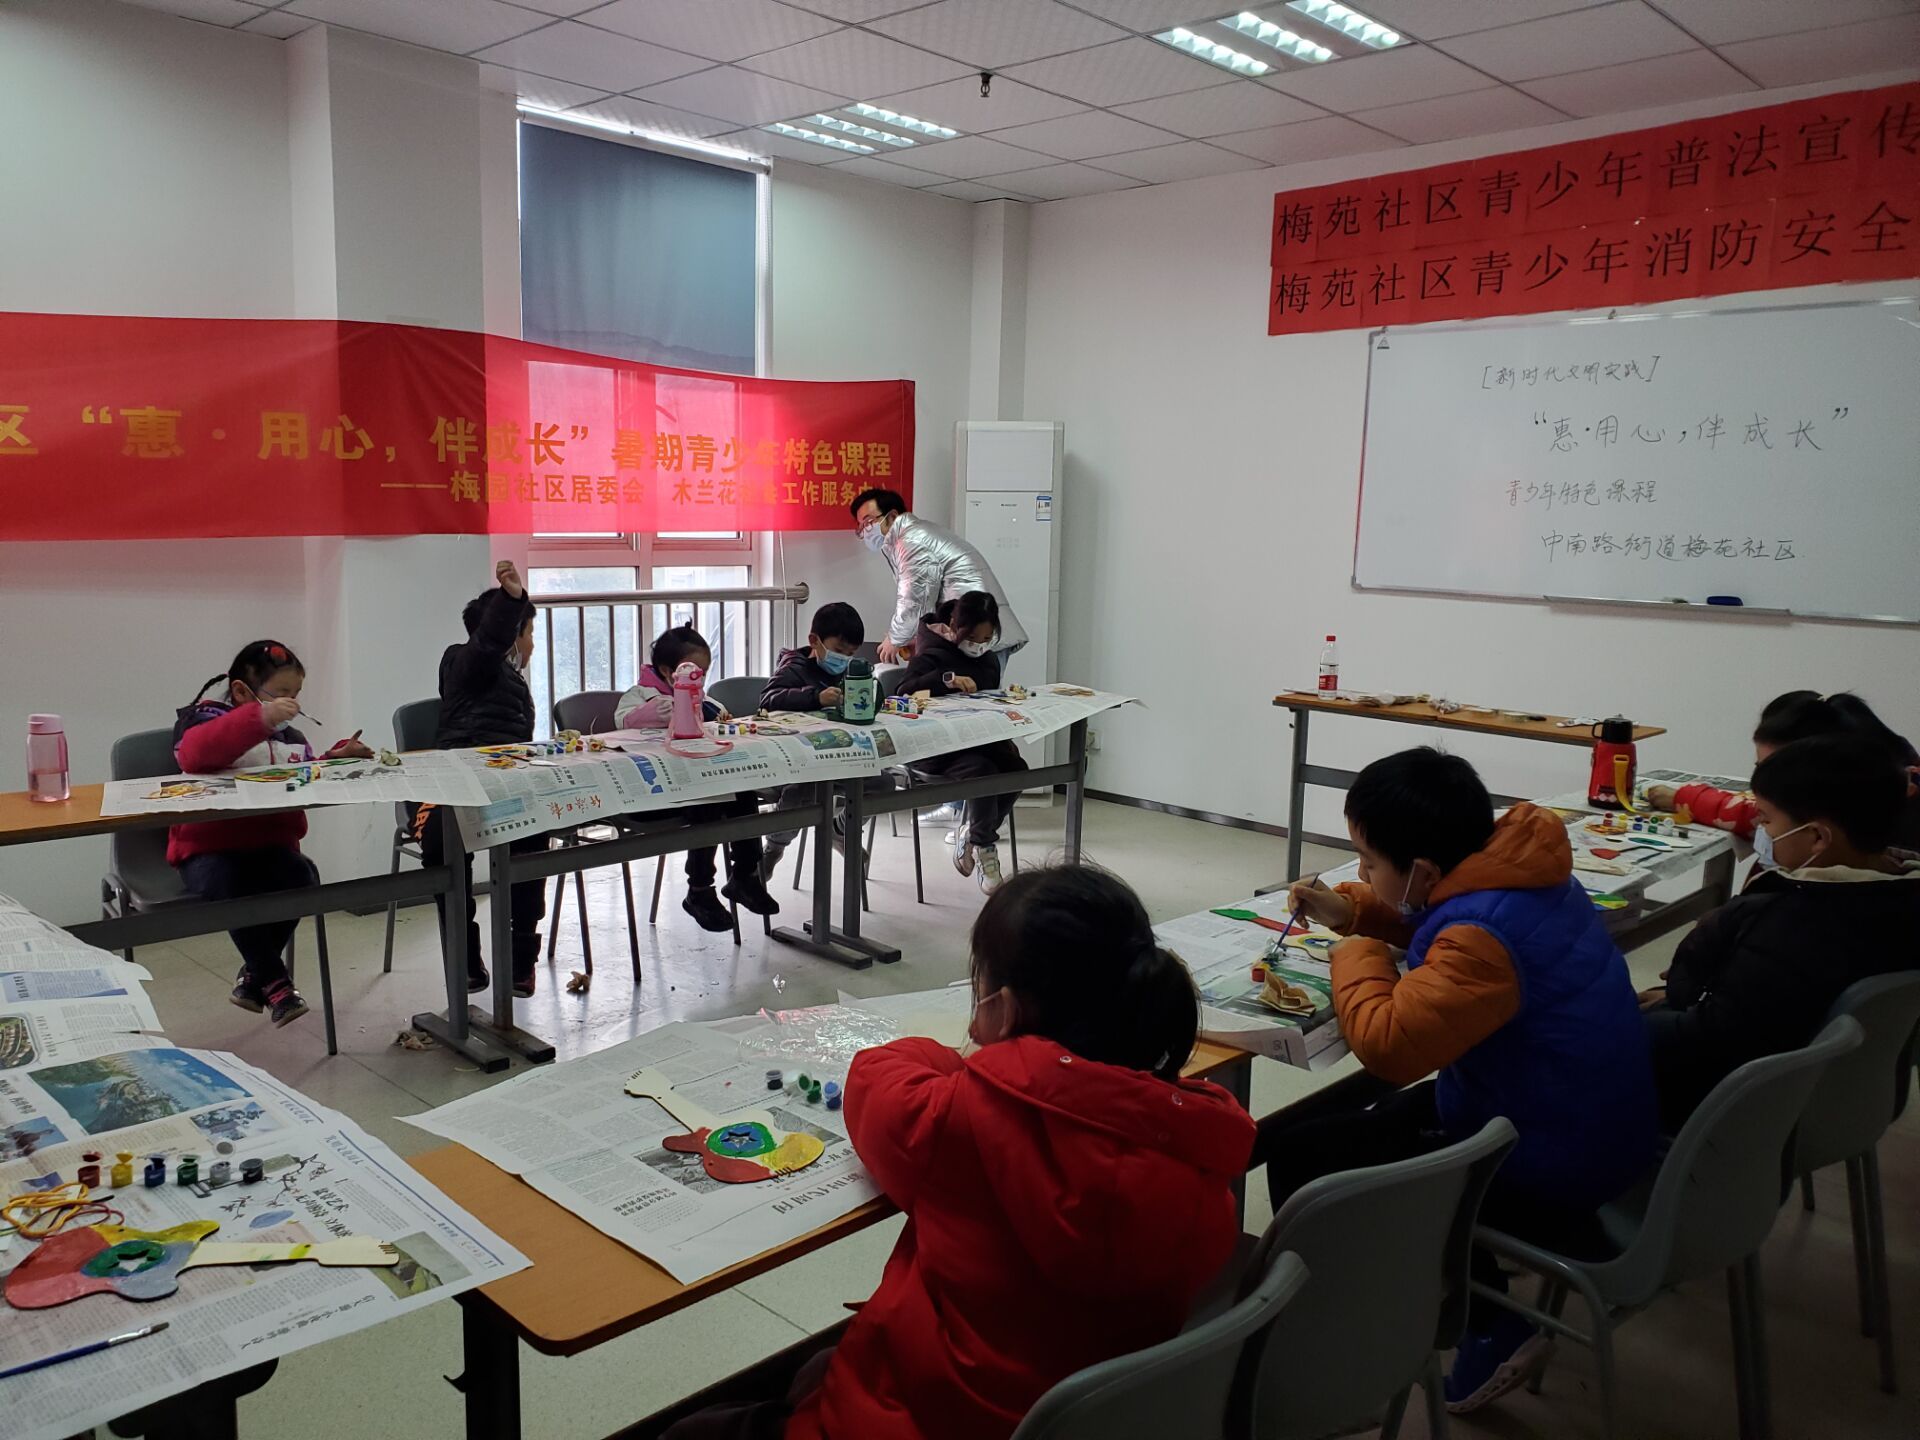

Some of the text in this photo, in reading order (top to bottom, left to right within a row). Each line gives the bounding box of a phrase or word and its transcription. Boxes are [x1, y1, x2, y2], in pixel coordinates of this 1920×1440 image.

[1278, 102, 1920, 247] 梅苑社区青少年普法宣传
[1274, 200, 1912, 316] 梅苑社区青少年消防安全
[1505, 479, 1657, 511] 青少年特色课程
